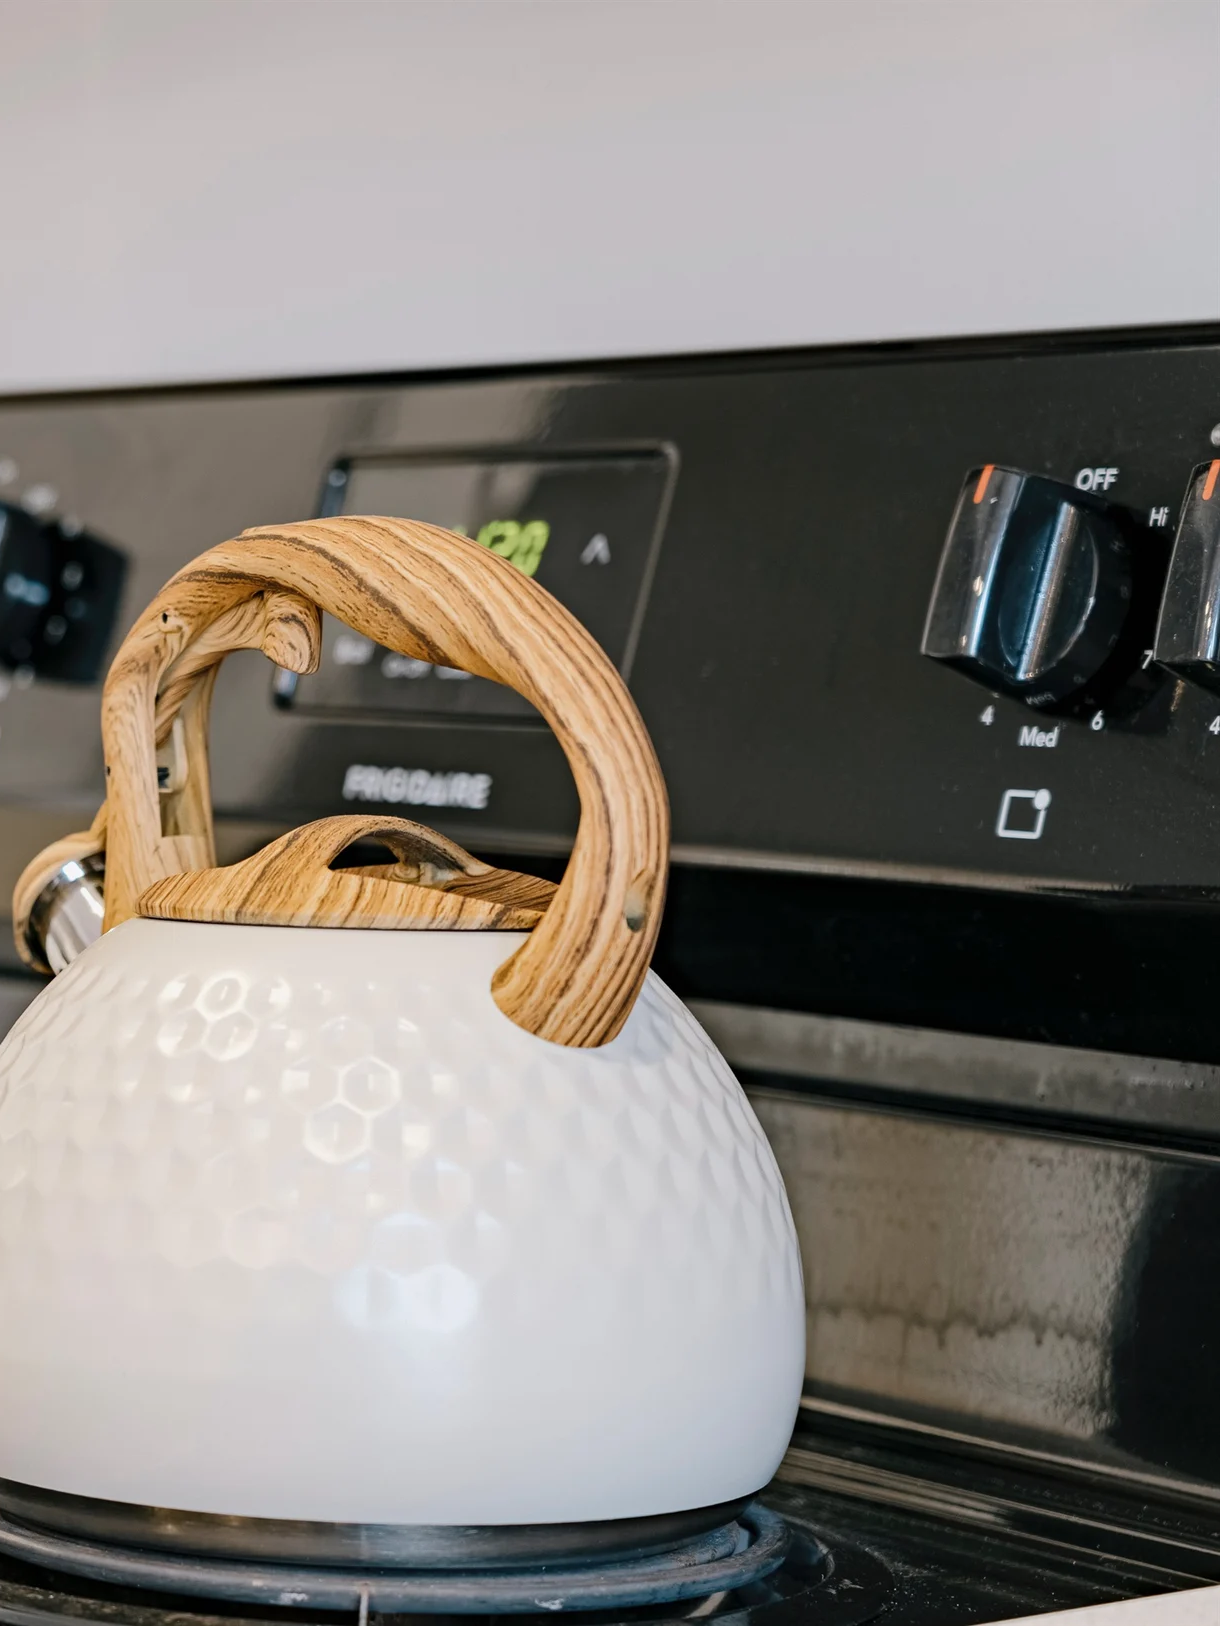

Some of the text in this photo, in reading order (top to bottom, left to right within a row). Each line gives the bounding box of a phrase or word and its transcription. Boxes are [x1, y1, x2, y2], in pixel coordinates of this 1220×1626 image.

[1075, 467, 1119, 491] OFF
[1148, 506, 1169, 527] Hi
[1141, 649, 1153, 670] 7
[980, 704, 994, 726] 4
[1092, 709, 1104, 731] 6
[1018, 725, 1060, 748] Med
